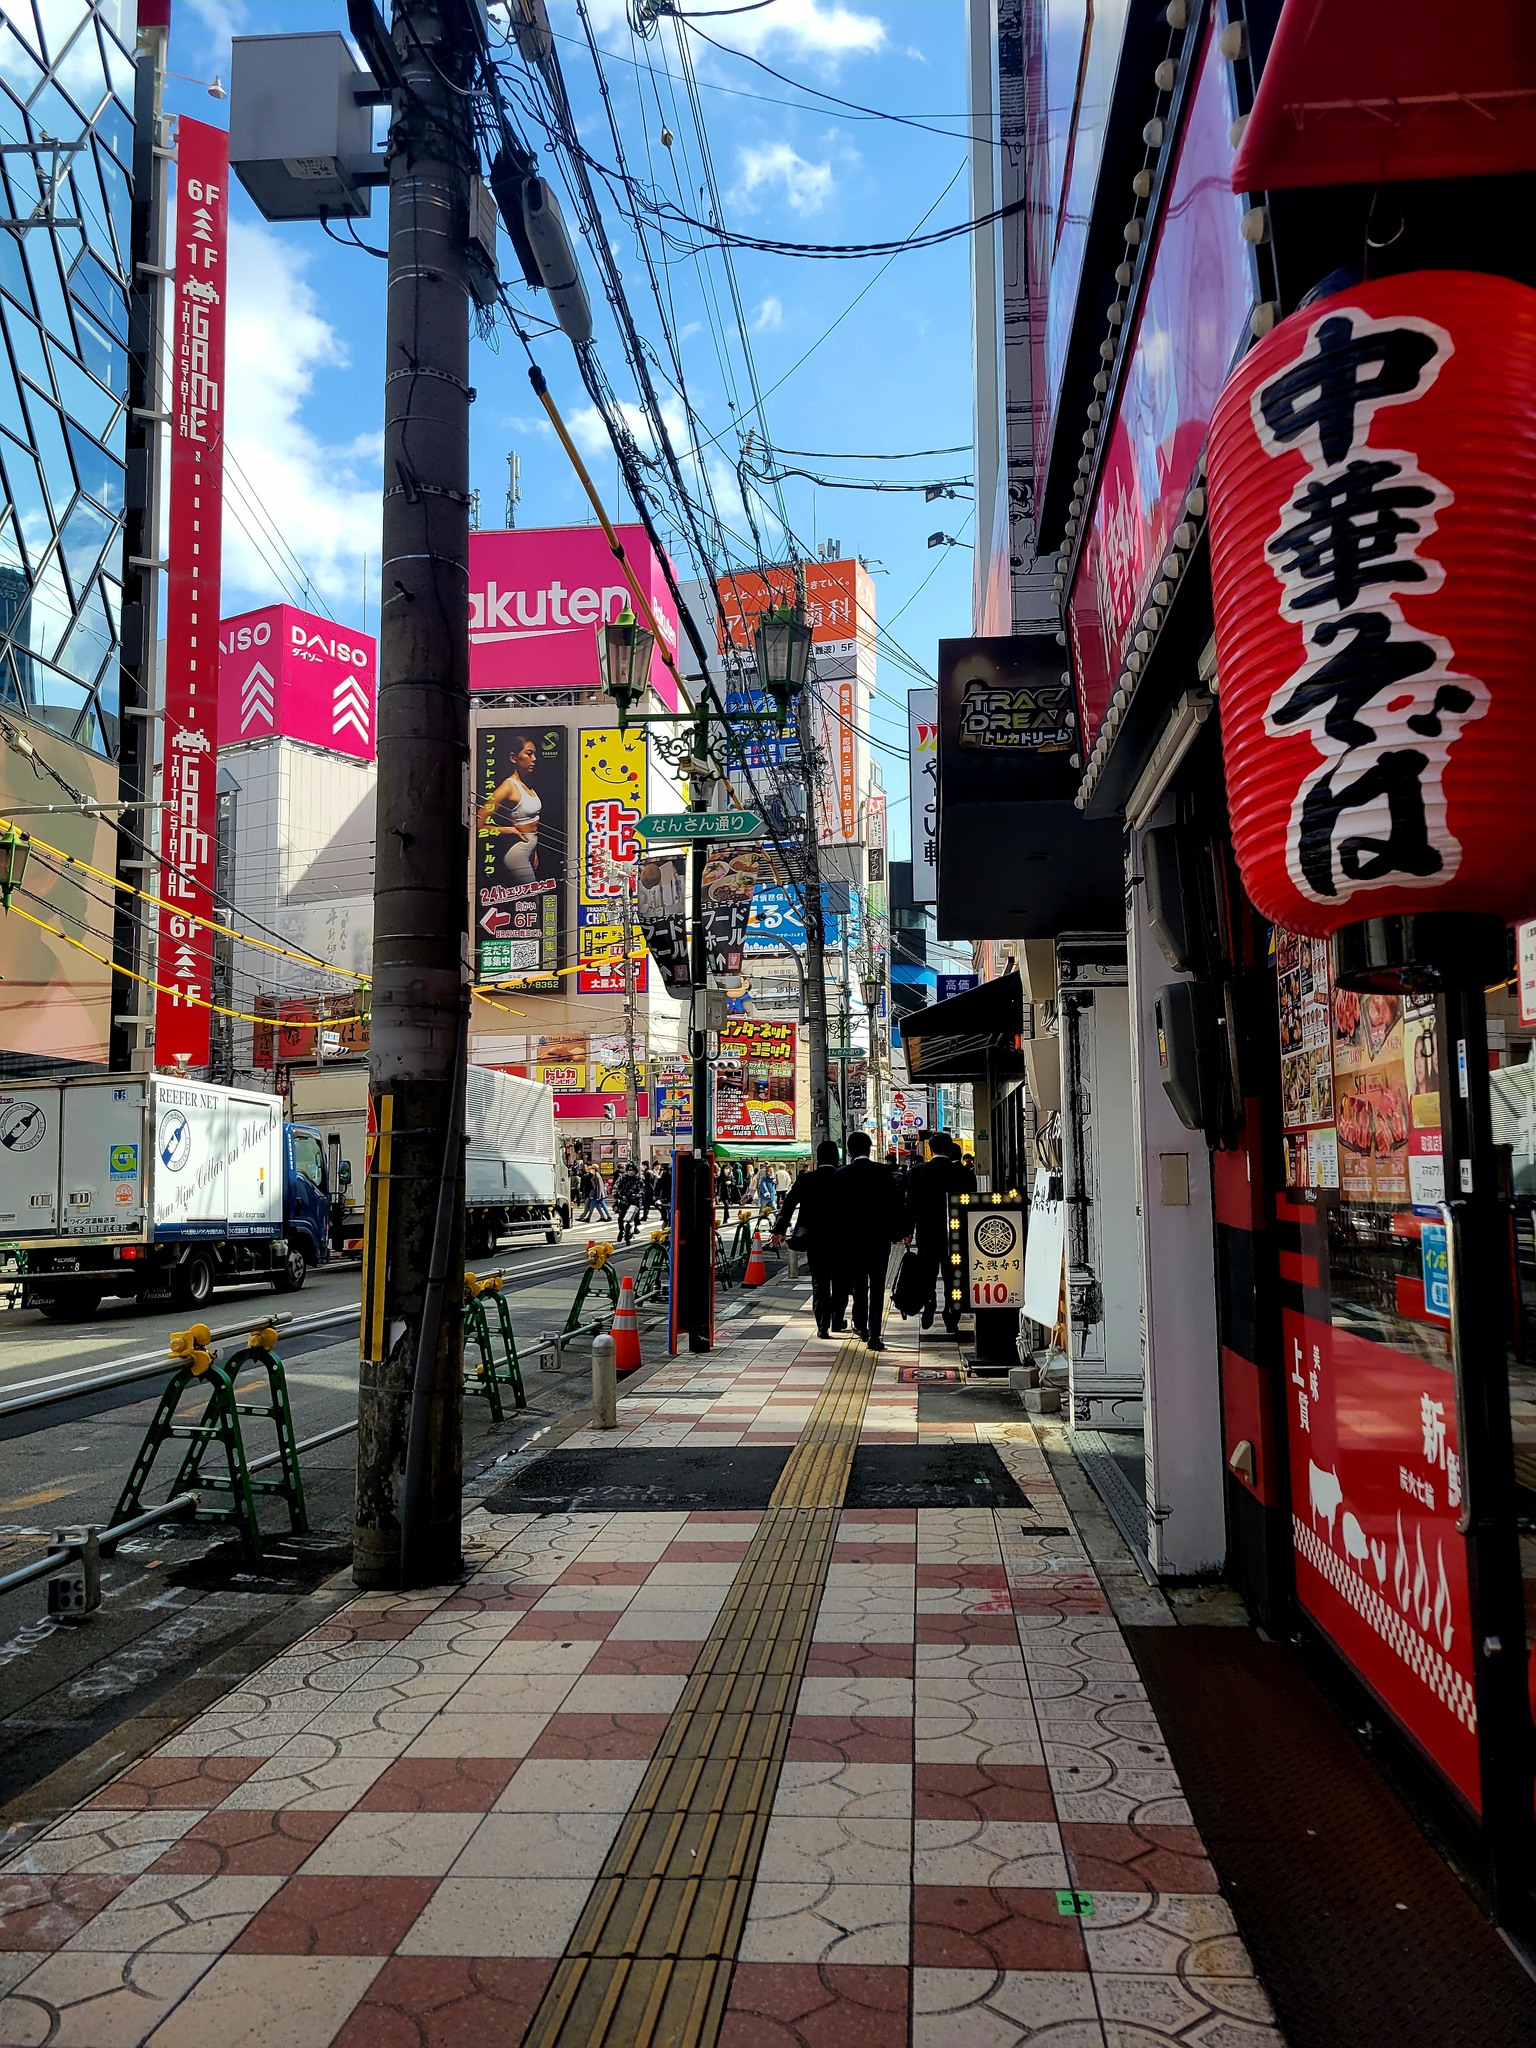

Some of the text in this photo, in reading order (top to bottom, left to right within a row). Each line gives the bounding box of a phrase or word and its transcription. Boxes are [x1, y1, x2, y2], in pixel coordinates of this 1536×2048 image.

[188, 178, 220, 206] 6F
[187, 243, 219, 269] 1F
[179, 301, 190, 437] TAITO STATION
[191, 306, 219, 442] GAME
[468, 581, 632, 629] akuten
[1256, 312, 1480, 898] 中華そば
[291, 625, 368, 667] DAISO
[292, 647, 324, 663] ダイソー
[841, 642, 853, 652] 5F
[985, 730, 1069, 744] トレカドリーム
[168, 755, 180, 897] TAITO STATION
[179, 757, 209, 898] GAME
[652, 816, 745, 833] なんさん通り
[170, 914, 203, 939] 6F
[515, 913, 537, 927] 6F
[641, 919, 683, 941] フード
[702, 908, 748, 930] フード
[595, 932, 608, 940] 4F
[705, 928, 747, 951] ホール
[483, 946, 510, 955] 友だち
[483, 957, 510, 966] 募集中
[169, 983, 202, 1008] 1F
[946, 980, 970, 991] 高価
[720, 1021, 792, 1039] インターネット
[750, 1042, 791, 1058] コミック
[545, 1069, 576, 1079] トレカ
[1354, 1074, 1367, 1096] SET
[159, 1087, 219, 1110] REEFER NET
[972, 1282, 1008, 1304] 110
